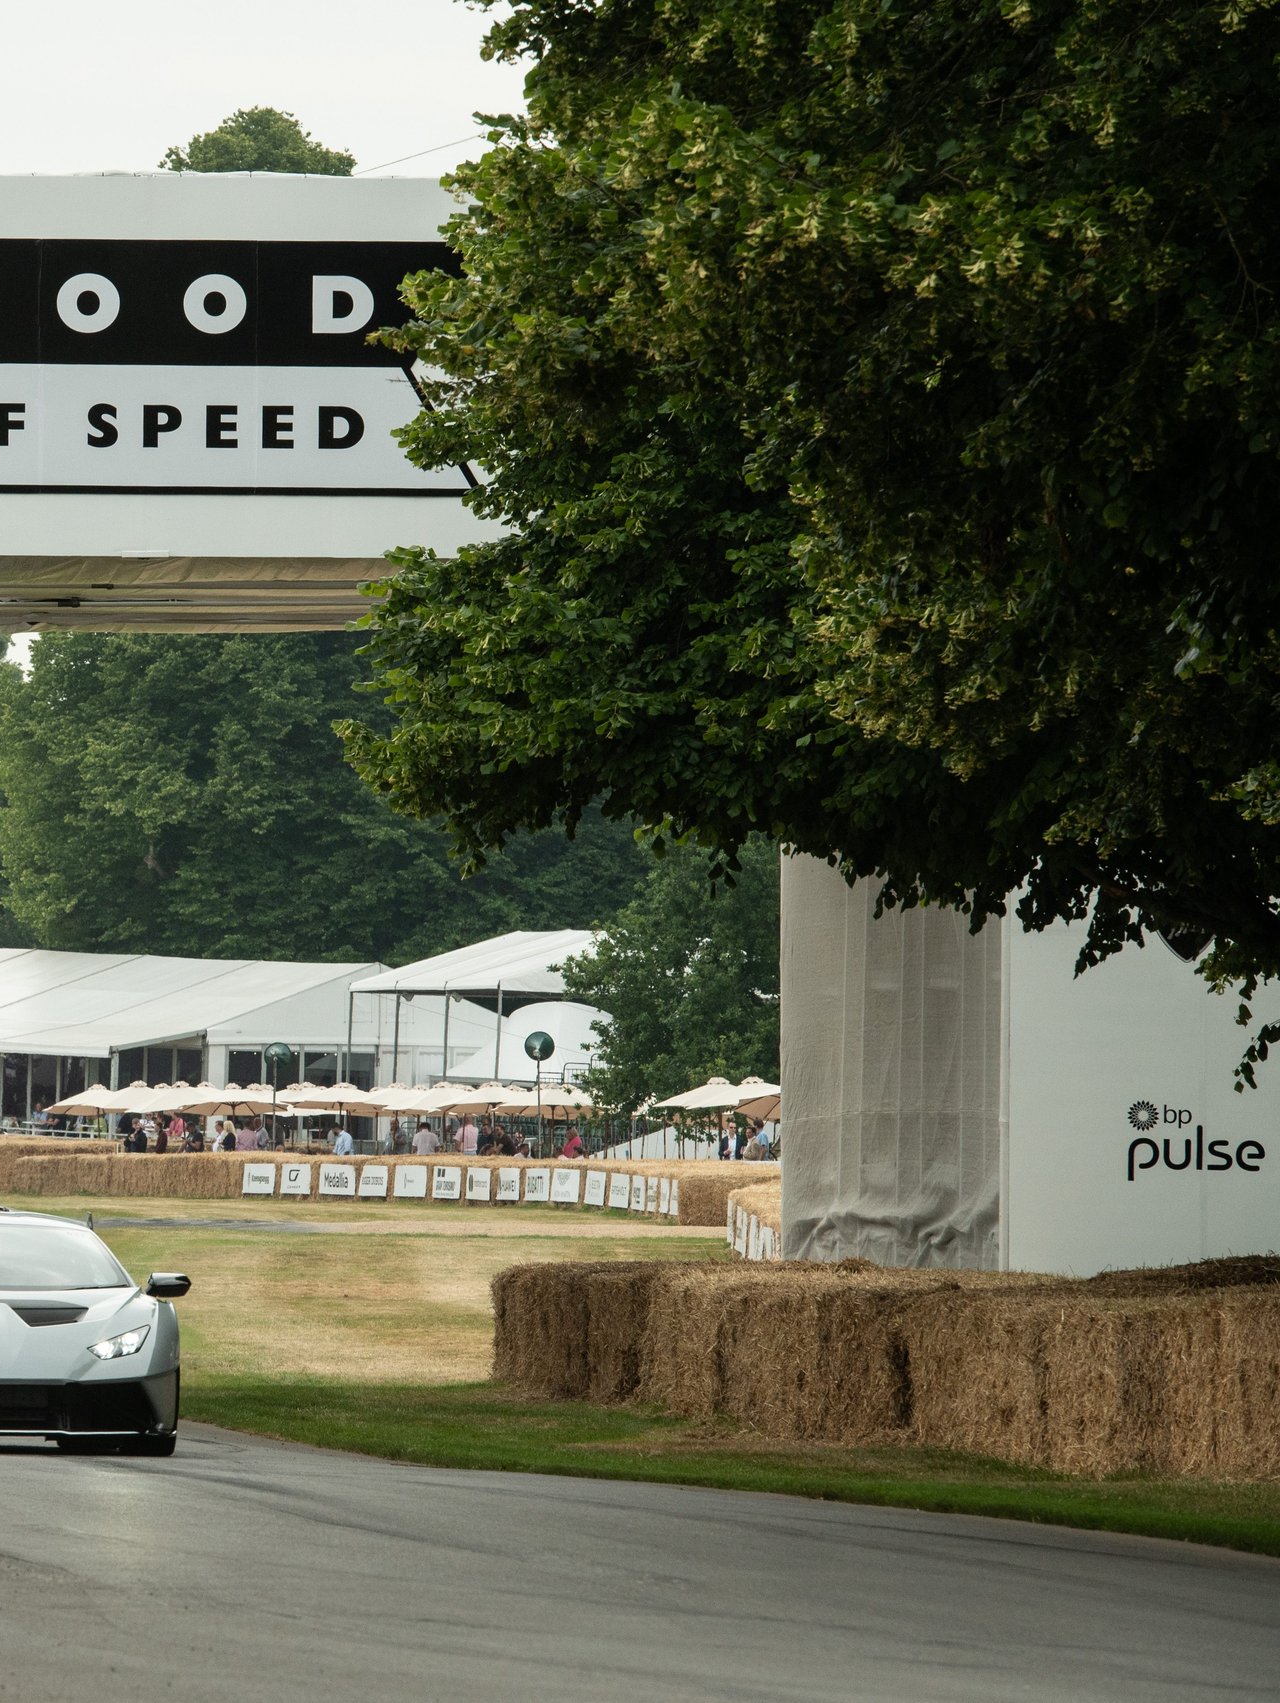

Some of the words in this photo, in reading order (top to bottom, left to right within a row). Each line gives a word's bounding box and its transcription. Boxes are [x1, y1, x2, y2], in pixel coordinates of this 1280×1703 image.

[87, 402, 365, 450] SPEED
[1163, 1104, 1193, 1129] bp
[1127, 1124, 1266, 1182] pulse
[324, 1171, 349, 1189] Medallia
[527, 1175, 544, 1194] BUGATTI
